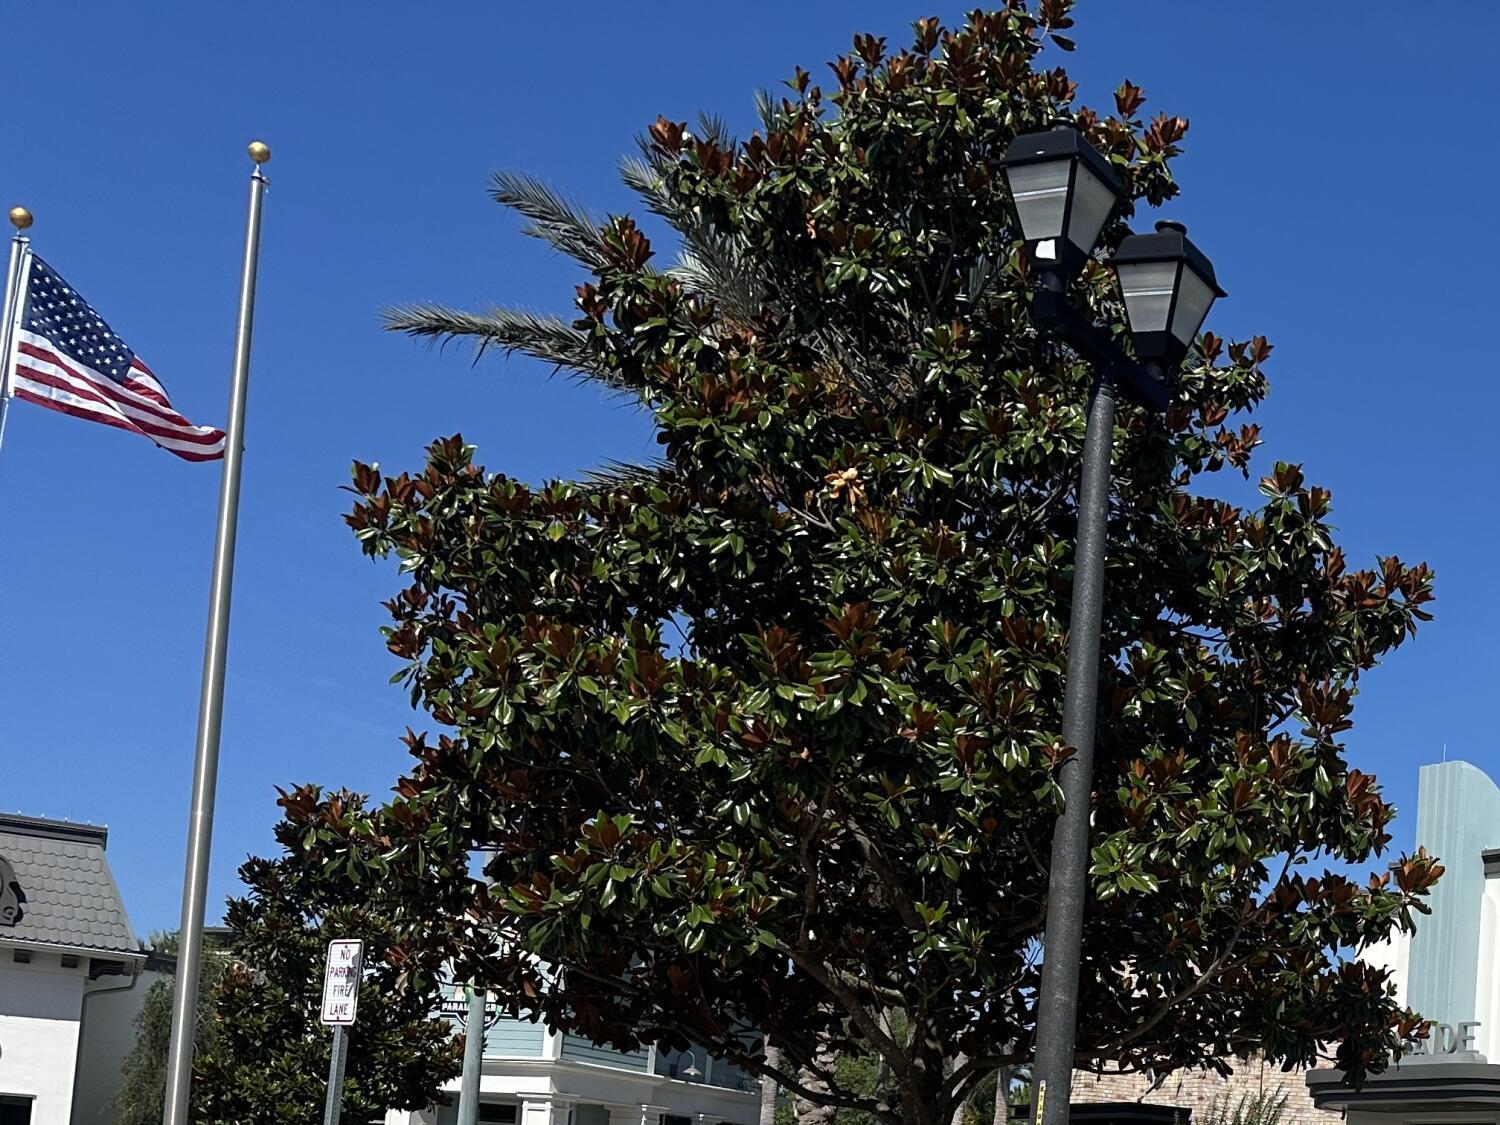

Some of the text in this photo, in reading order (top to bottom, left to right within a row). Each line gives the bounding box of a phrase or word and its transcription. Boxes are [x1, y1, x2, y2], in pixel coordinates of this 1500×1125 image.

[340, 949, 351, 960] NO
[329, 966, 357, 978] PARKING
[333, 985, 350, 997] FIRE
[329, 1003, 348, 1015] LANE
